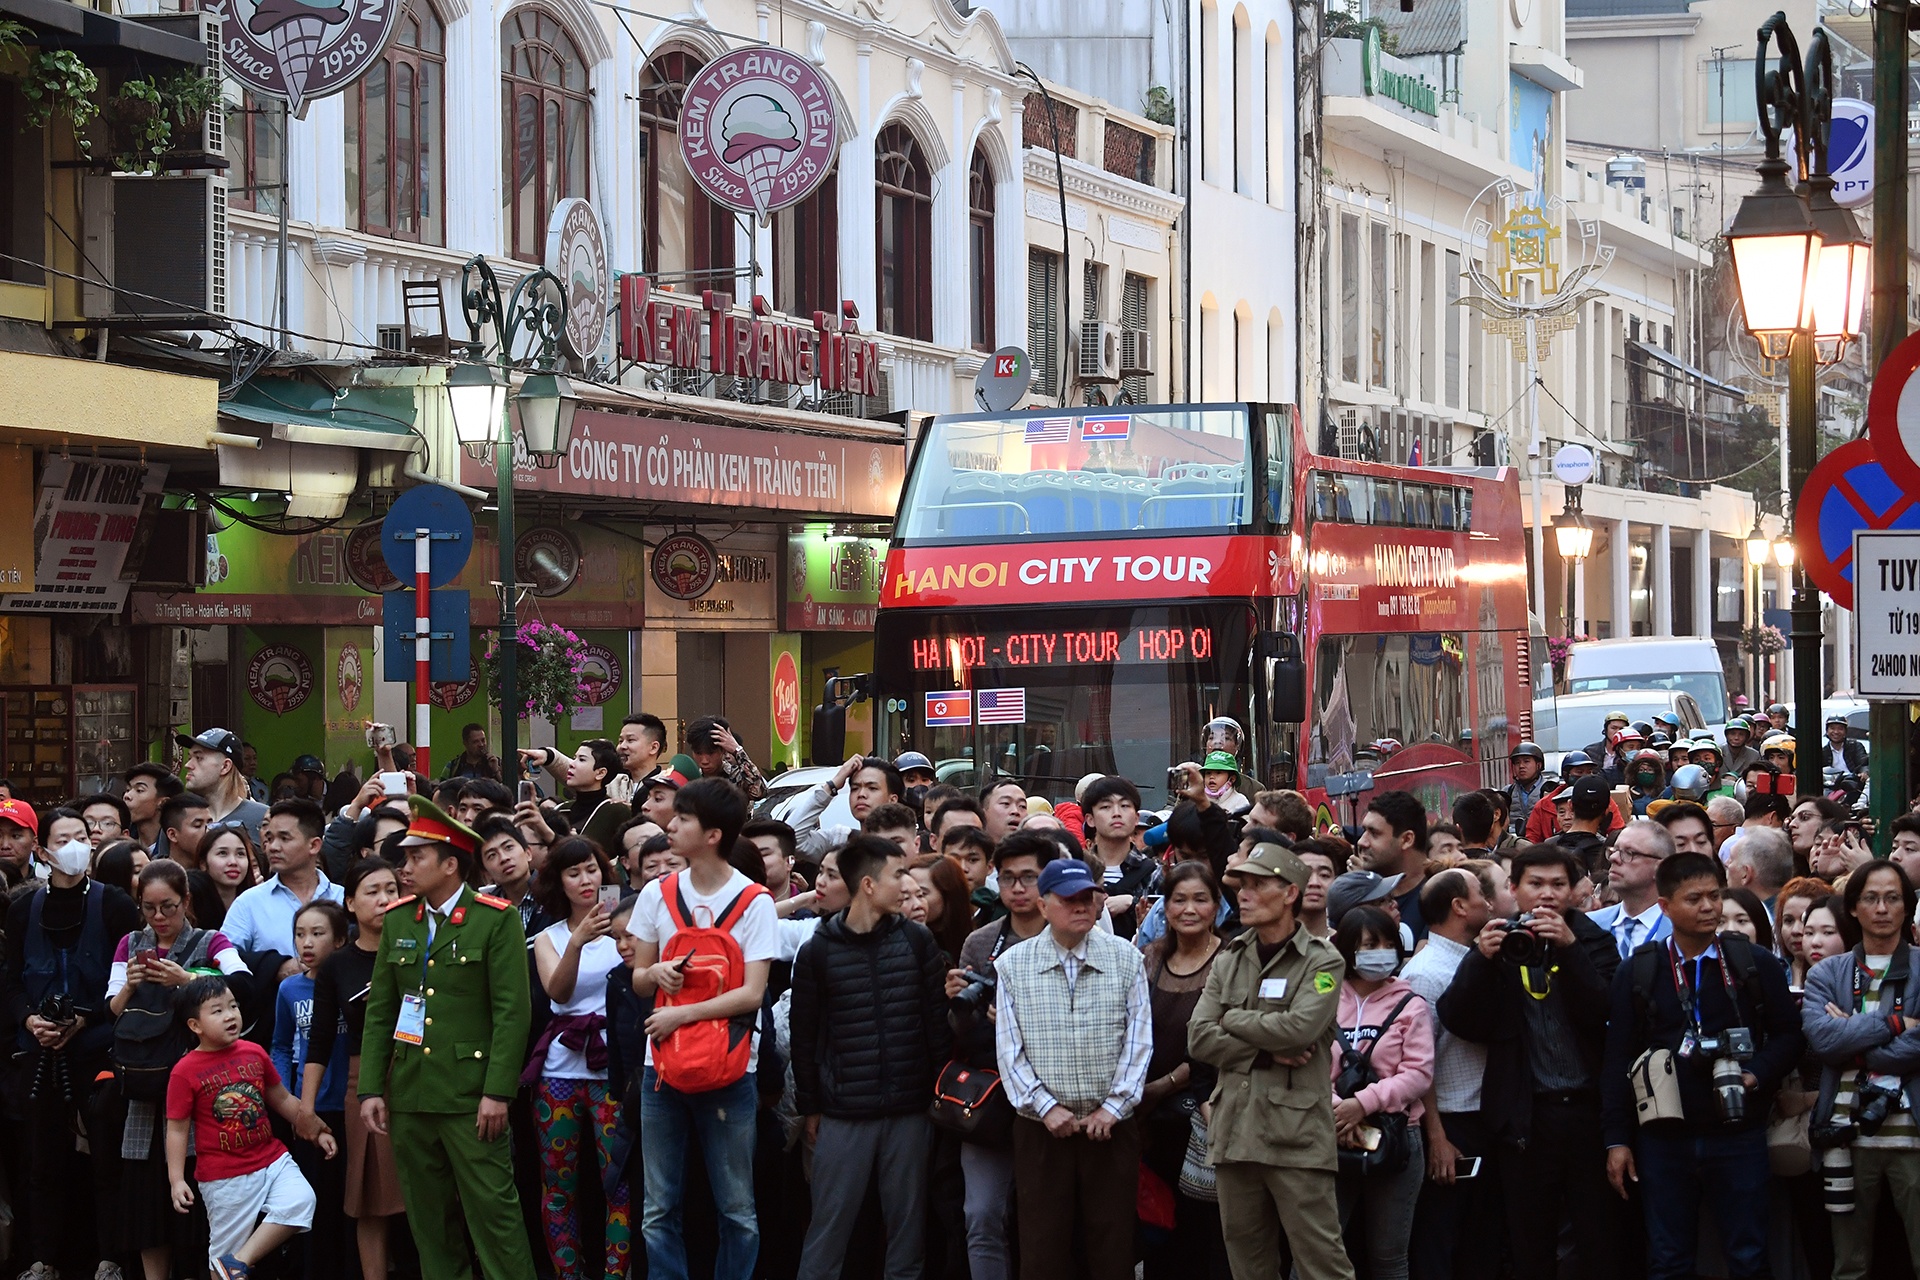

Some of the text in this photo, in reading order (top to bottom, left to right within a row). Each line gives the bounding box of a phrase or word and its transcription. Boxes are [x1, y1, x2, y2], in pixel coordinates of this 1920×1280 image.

[222, 37, 274, 81] Since
[318, 32, 368, 80] 1958
[686, 96, 711, 159] KEM
[704, 53, 801, 92] TRÀNG
[702, 166, 745, 199] Since
[779, 156, 817, 195] 1958
[1833, 180, 1869, 192] NPT
[621, 274, 880, 397] KEM TRÀNG TIỀN
[998, 359, 1018, 374] K+
[570, 424, 617, 482] CÔNG
[622, 443, 643, 484] TY
[647, 434, 669, 487] CỔ
[673, 438, 715, 490] PHẦN
[719, 453, 750, 493] KEM
[753, 445, 802, 497] TRÀNG
[805, 450, 837, 499] TIỀN
[829, 546, 861, 592] KEM
[894, 562, 1009, 599] HANOI
[1018, 557, 1102, 585] CITY
[1112, 556, 1212, 584] TOUR
[1374, 544, 1408, 587] HANOI
[1408, 546, 1430, 588] CITY
[1430, 546, 1456, 589] TOUR
[1878, 559, 1920, 591] TUY
[1888, 606, 1920, 635] TỪ 19
[1006, 633, 1057, 665] CITY
[1063, 631, 1121, 663] TOUR
[1139, 629, 1185, 660] HOP
[250, 666, 261, 689] KEM
[1910, 654, 1920, 677] N
[775, 678, 798, 725] Key
[396, 1031, 421, 1044] SECURITY
[201, 1069, 232, 1096] HOT
[219, 1122, 271, 1151] RACIN
